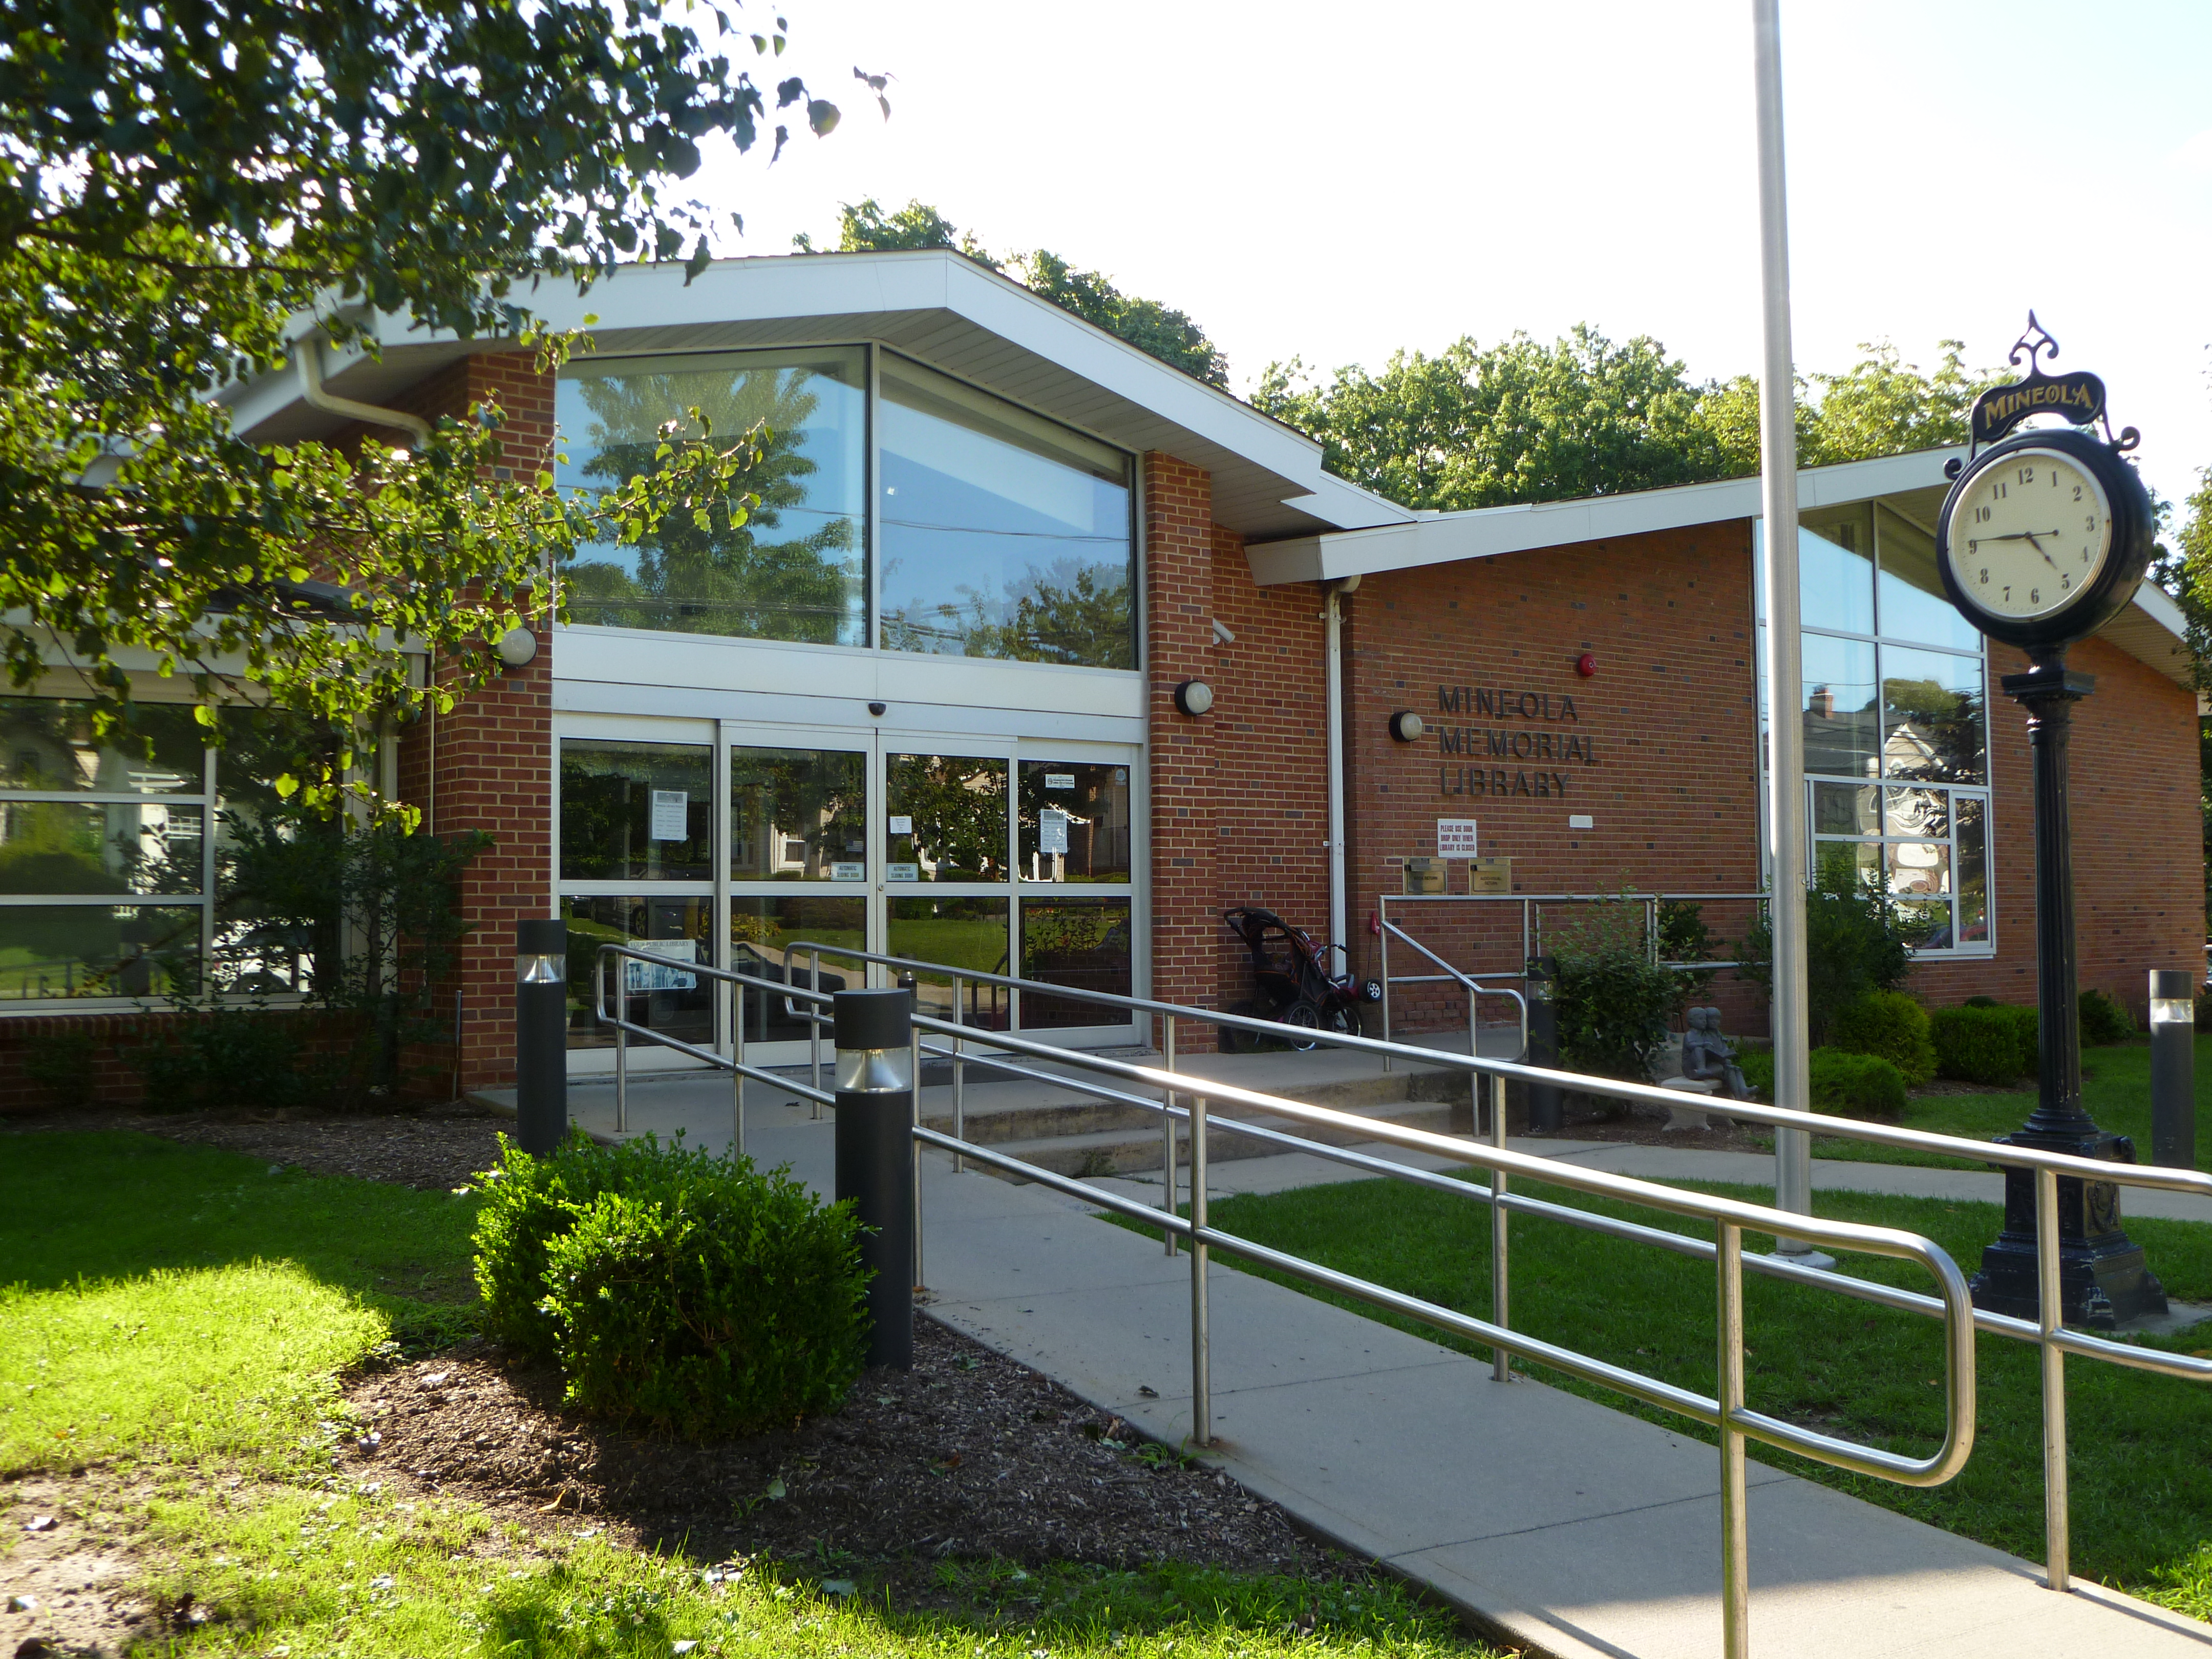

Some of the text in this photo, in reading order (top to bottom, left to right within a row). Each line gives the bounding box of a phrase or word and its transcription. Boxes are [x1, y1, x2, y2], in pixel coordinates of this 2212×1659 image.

[1984, 383, 2094, 430] MINEOLA
[2018, 467, 2034, 485] 12
[2052, 471, 2058, 486] 1
[1993, 482, 2007, 500] 11
[2073, 485, 2082, 502] 2
[1975, 505, 1991, 523] 10
[2086, 515, 2095, 532] 3
[1968, 539, 1977, 555] 9
[2080, 545, 2089, 562] 4
[1980, 568, 1989, 584] 8
[2061, 572, 2070, 589] 5
[2003, 586, 2011, 602] 7
[2031, 588, 2039, 604] 6
[1439, 685, 1578, 721] MINEOLA
[1439, 727, 1599, 762] MEMORIAL
[1440, 768, 1570, 797] LIBRARY
